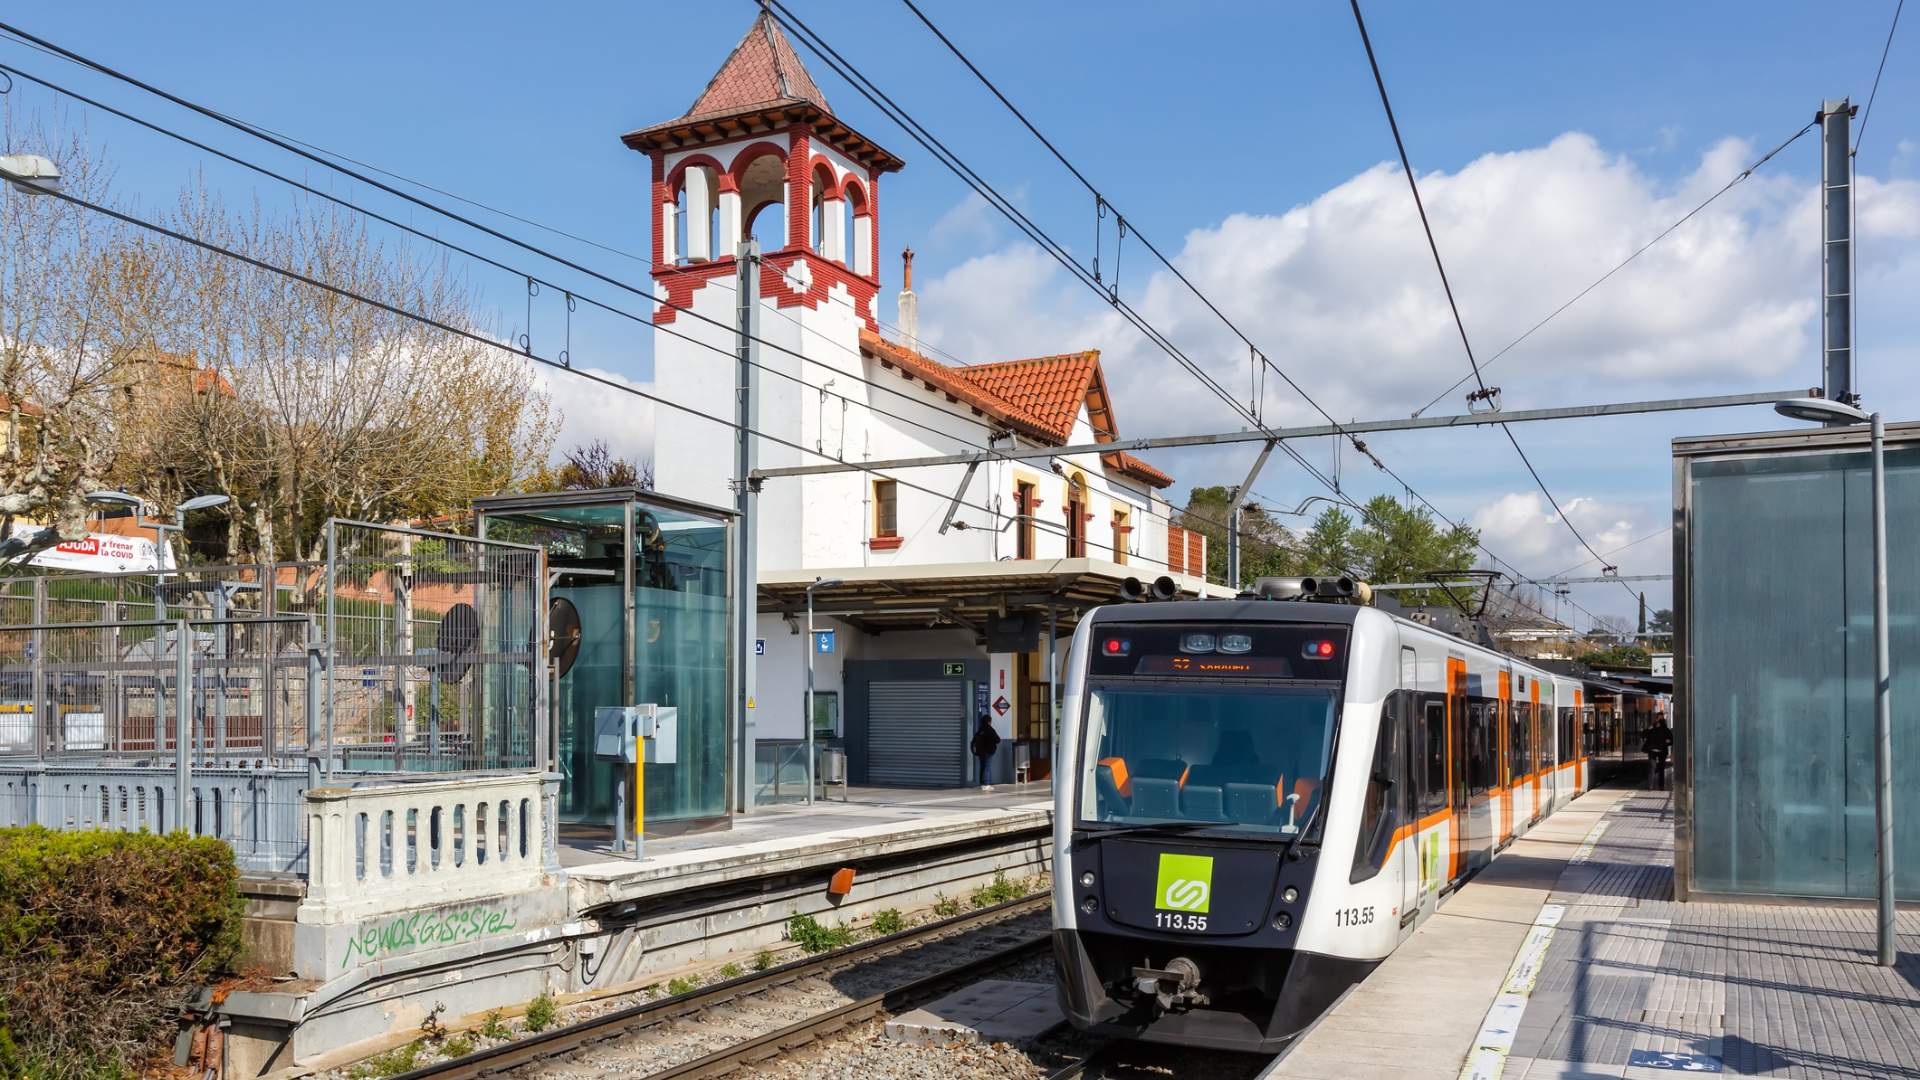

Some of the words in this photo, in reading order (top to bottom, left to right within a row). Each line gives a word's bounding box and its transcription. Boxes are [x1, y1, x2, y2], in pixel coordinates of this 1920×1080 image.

[109, 540, 134, 551] frenar
[101, 549, 109, 557] la
[110, 550, 134, 559] COVID
[1662, 664, 1666, 673] 1
[1155, 913, 1208, 931] 113.55
[1335, 906, 1375, 927] 113.55
